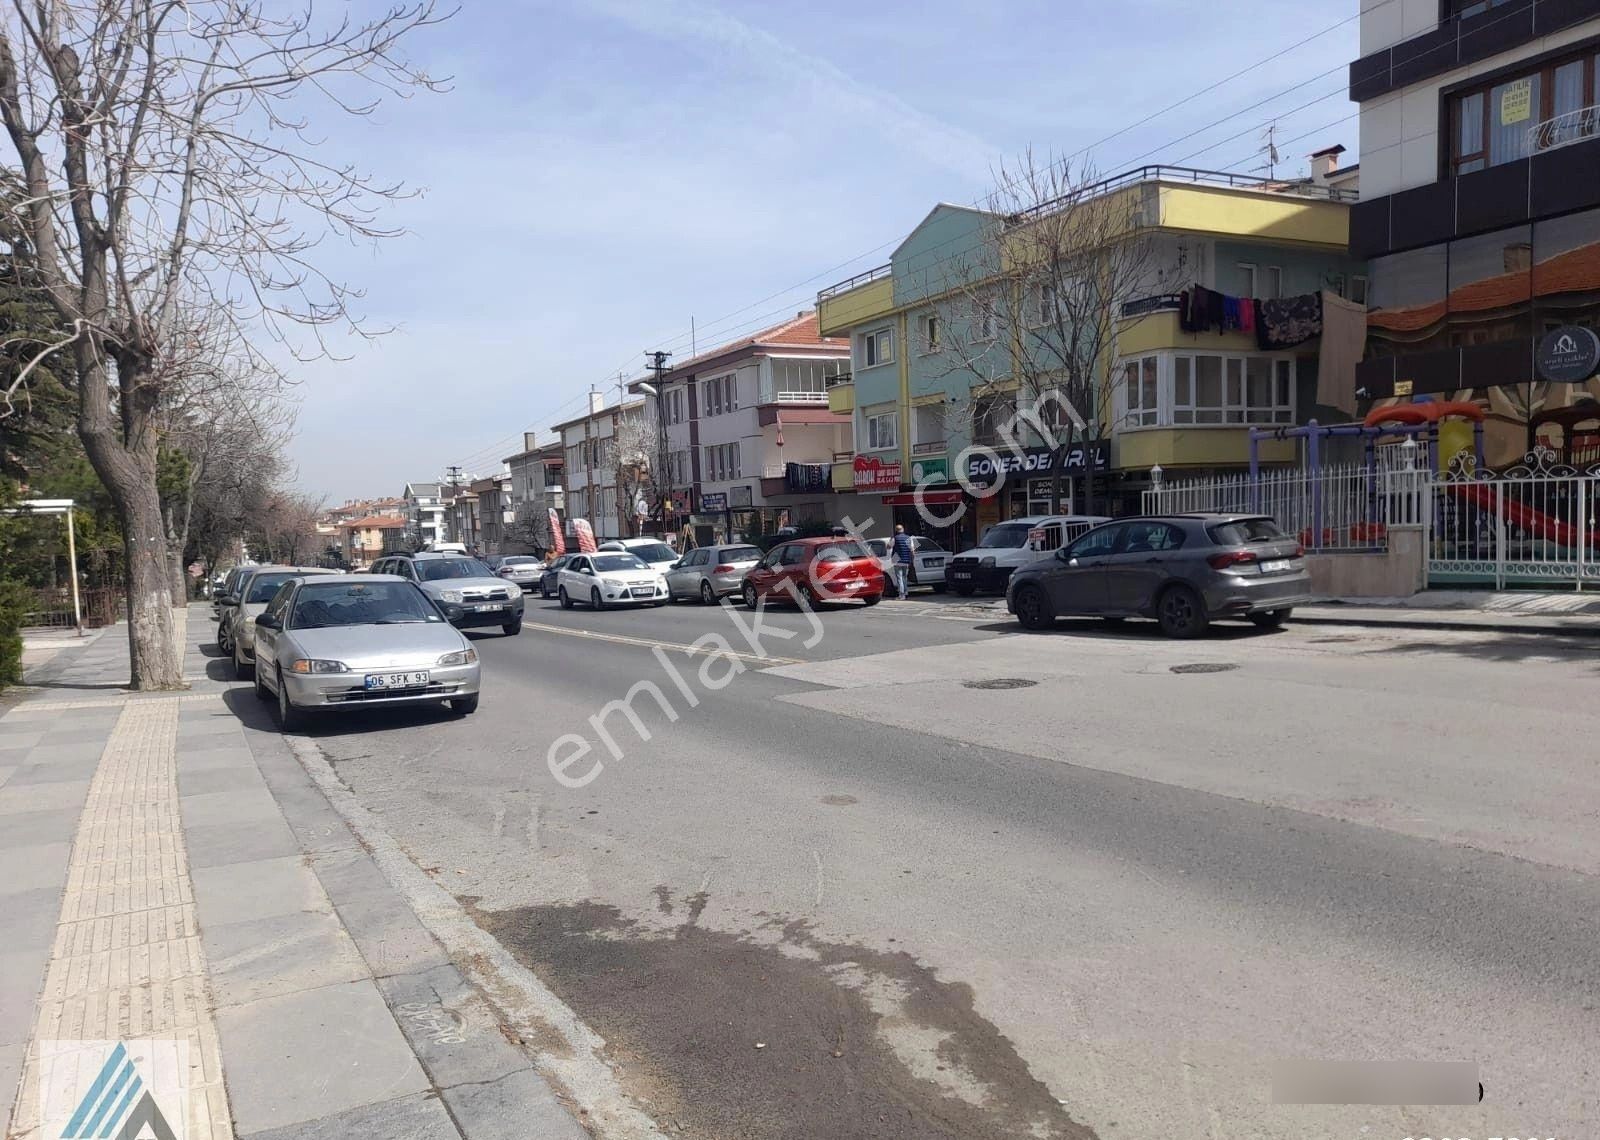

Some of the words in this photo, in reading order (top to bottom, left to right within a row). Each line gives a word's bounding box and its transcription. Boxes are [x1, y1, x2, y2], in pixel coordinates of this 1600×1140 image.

[969, 456, 1022, 476] SONER
[1025, 447, 1105, 471] DEIRL
[371, 675, 384, 686] 06
[390, 673, 409, 685] SFK
[415, 672, 428, 683] 93
